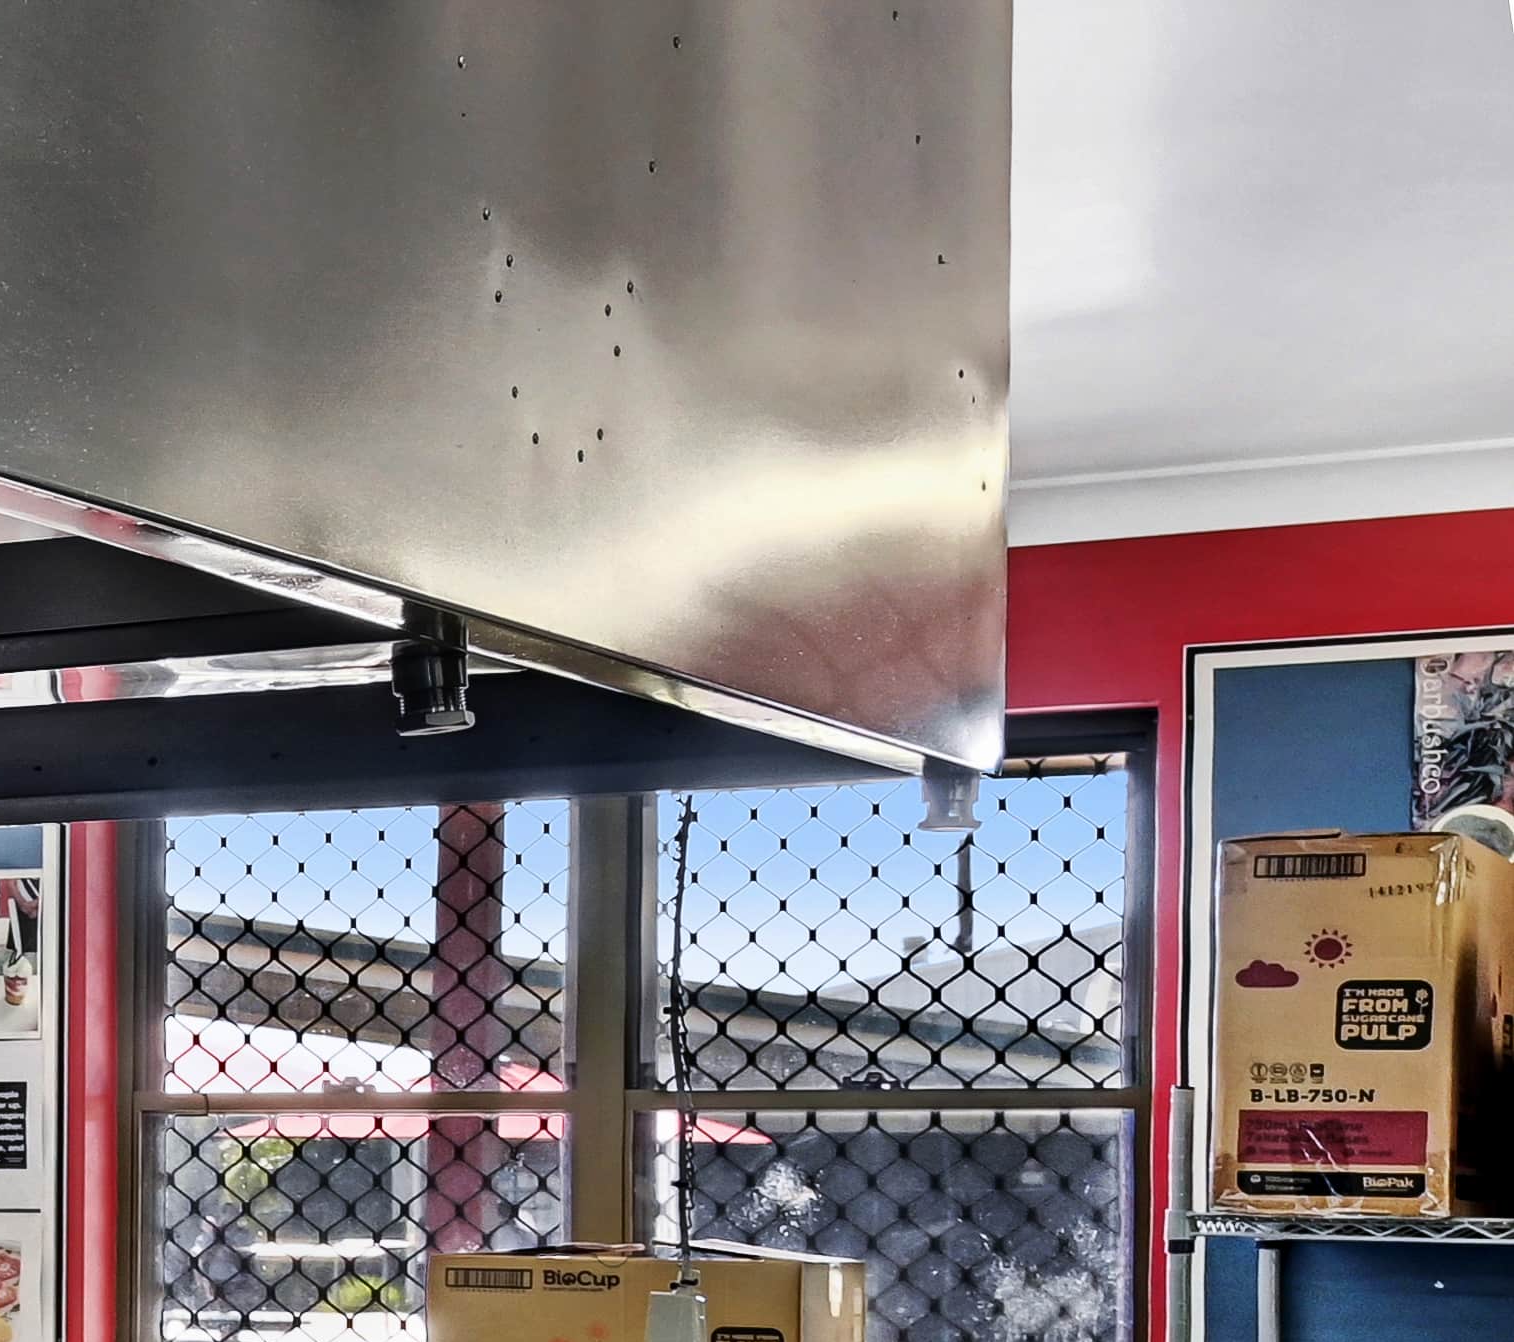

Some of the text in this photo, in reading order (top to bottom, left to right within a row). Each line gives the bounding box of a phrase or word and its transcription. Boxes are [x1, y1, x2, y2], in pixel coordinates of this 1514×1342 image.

[1368, 988, 1405, 997] MADE
[1342, 998, 1409, 1013] FROM
[1342, 1014, 1425, 1023] SUGARCANE
[1341, 1024, 1417, 1041] PULP
[1250, 1088, 1375, 1103] B-LB-750-N
[1363, 1176, 1414, 1190] BioPak
[543, 1269, 620, 1290] BioCup
